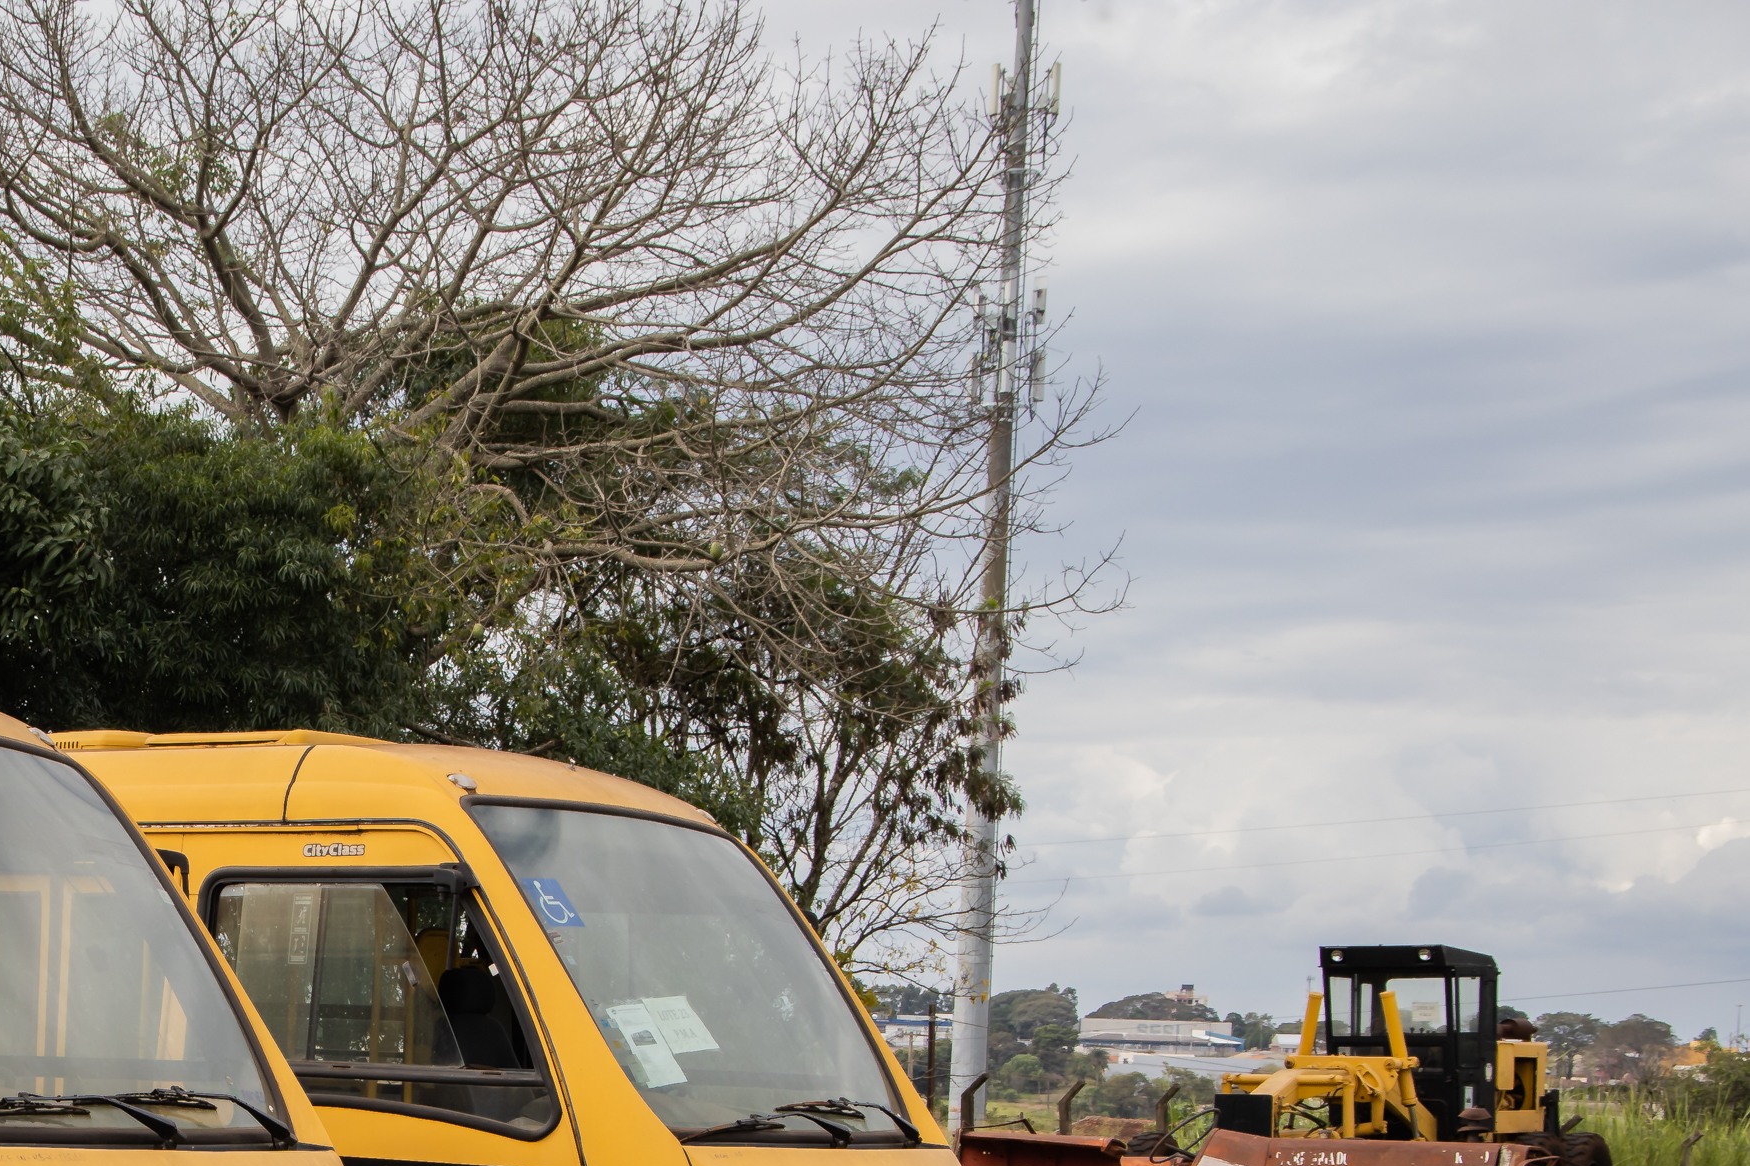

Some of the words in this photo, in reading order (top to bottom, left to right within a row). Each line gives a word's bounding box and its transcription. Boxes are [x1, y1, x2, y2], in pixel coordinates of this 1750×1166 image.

[303, 843, 365, 857] CityClass
[657, 1009, 680, 1021] LOTE
[677, 1008, 690, 1019] 23
